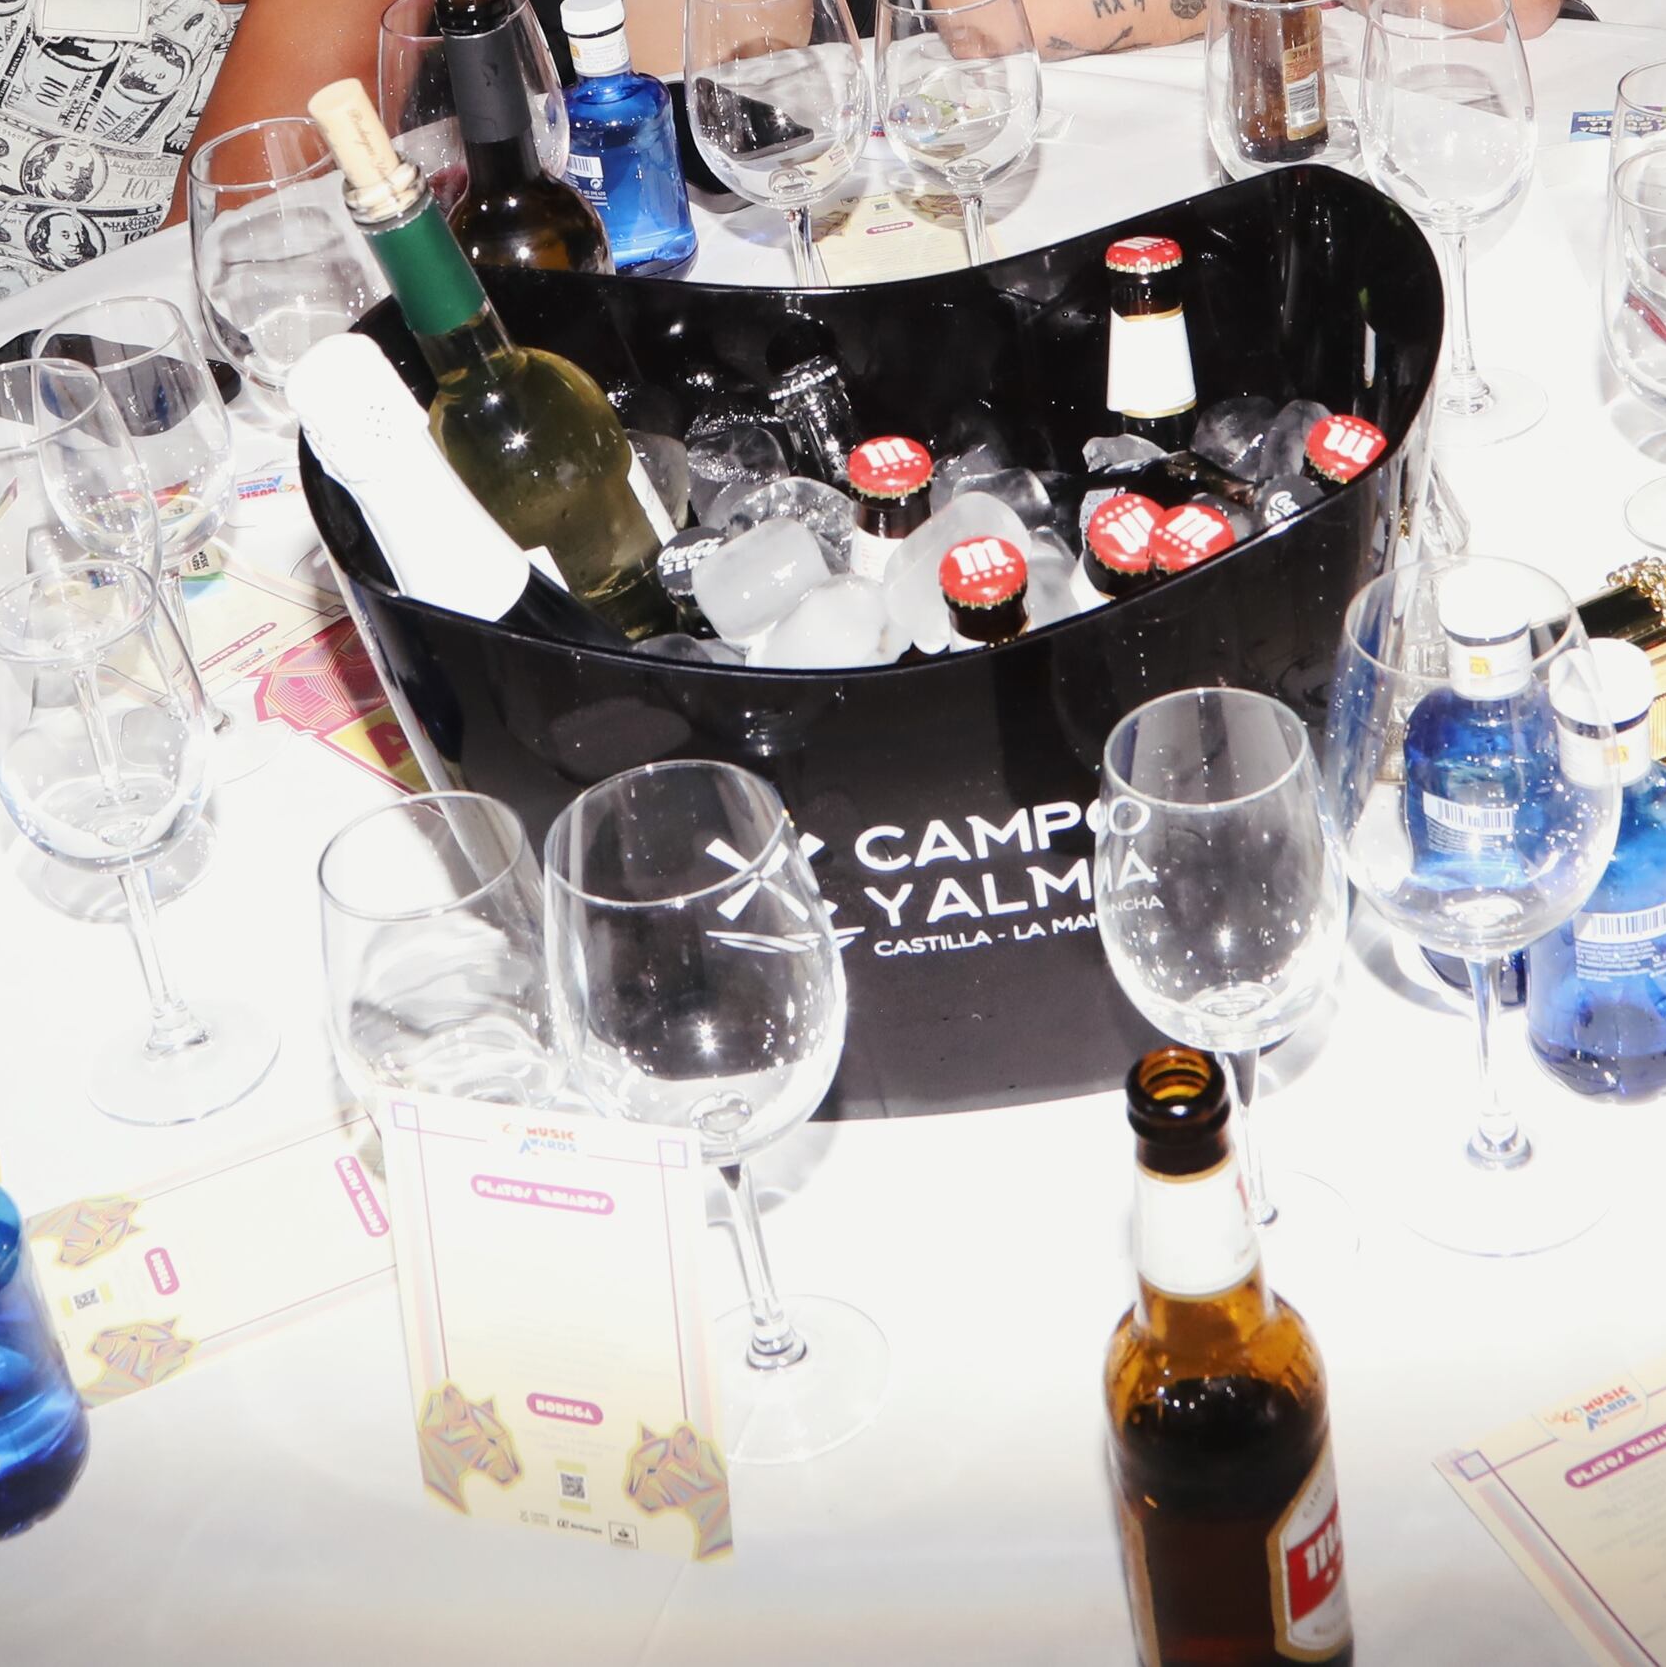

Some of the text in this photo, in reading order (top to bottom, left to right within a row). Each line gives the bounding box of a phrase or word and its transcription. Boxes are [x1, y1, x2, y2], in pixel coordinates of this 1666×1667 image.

[663, 558, 701, 576] ZER
[855, 797, 1151, 872] CAMPO
[873, 931, 992, 958] CASTILLA
[1013, 922, 1046, 941] LA
[519, 1136, 578, 1154] AWARDS
[525, 1124, 576, 1142] MUSIC
[476, 1179, 532, 1200] PLATOS
[533, 1397, 595, 1422] BODEGA
[1581, 1385, 1629, 1416] MUSIC
[1585, 1393, 1638, 1432] AWARDS
[1570, 1452, 1624, 1486] PLATOS
